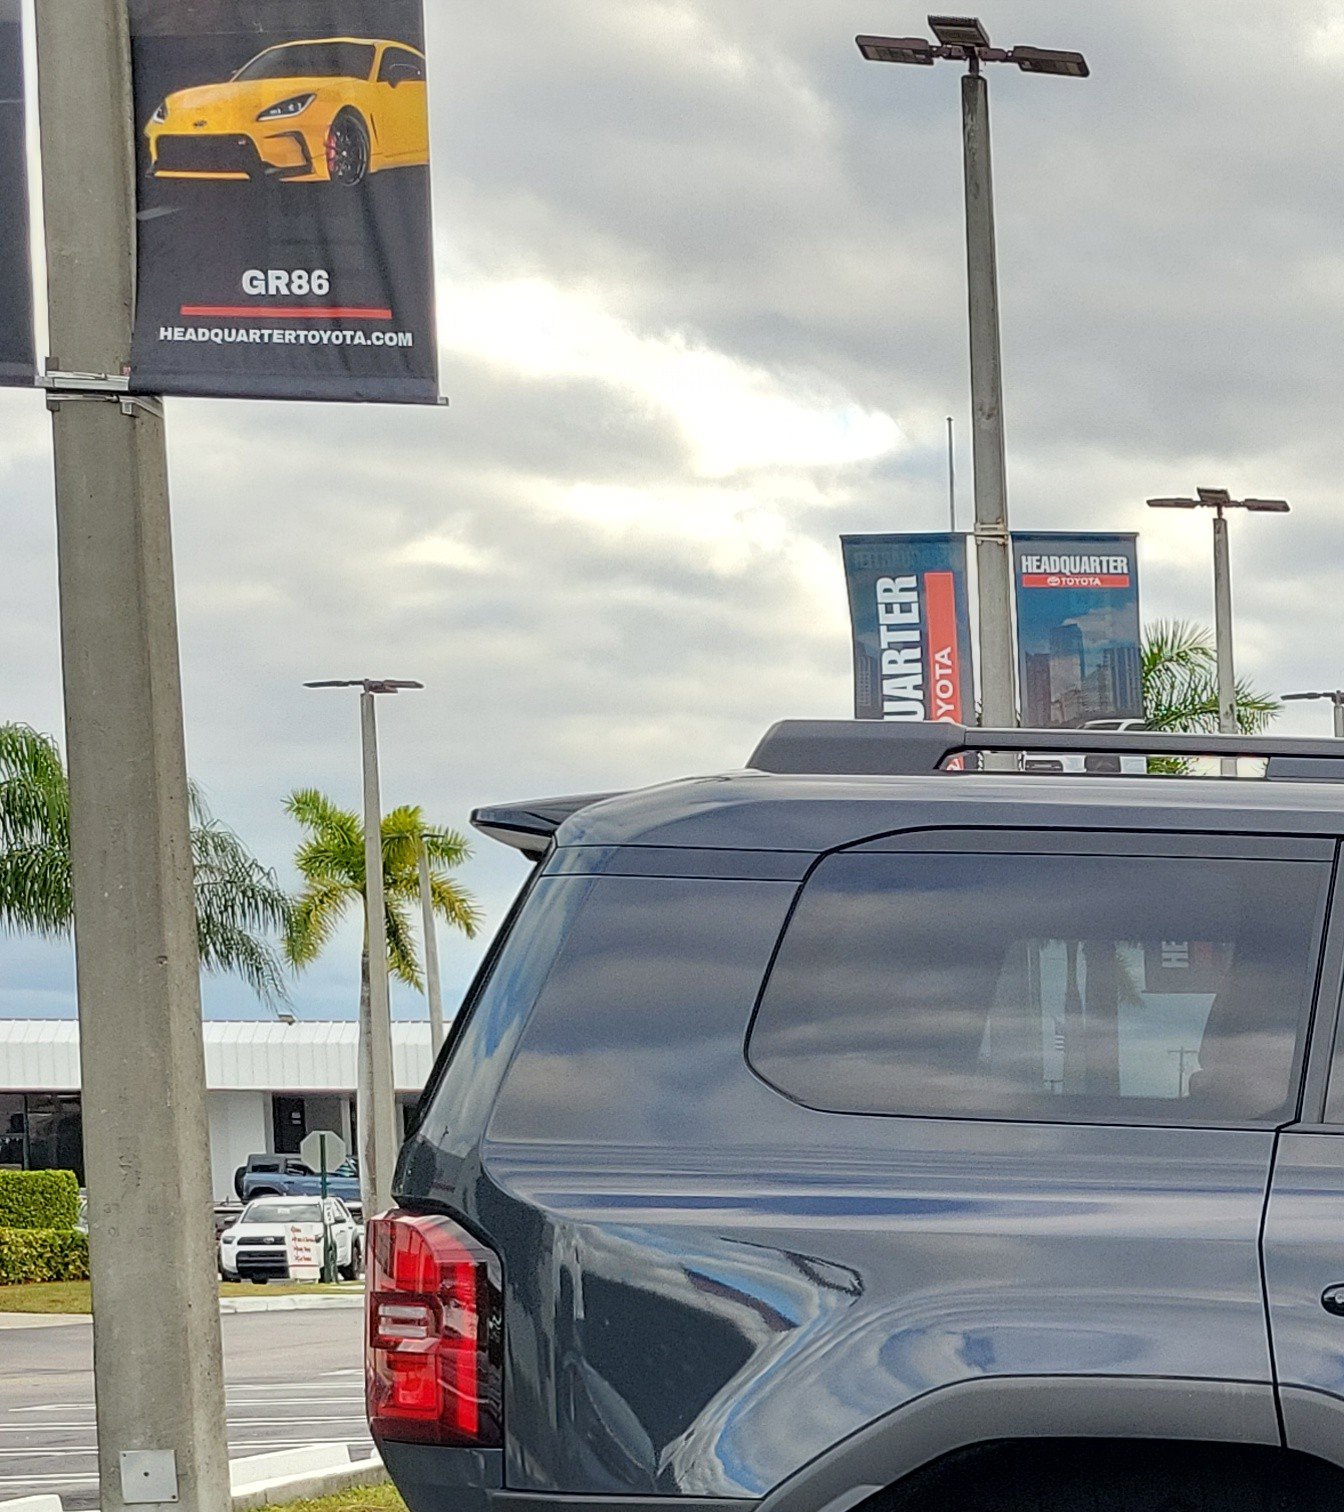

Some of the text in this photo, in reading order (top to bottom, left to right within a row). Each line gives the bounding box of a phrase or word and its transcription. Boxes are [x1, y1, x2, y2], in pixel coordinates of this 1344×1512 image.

[242, 269, 330, 297] GR86
[159, 326, 413, 347] HEADQUARTERTOYOTA.COM
[1021, 555, 1129, 575] HEADQUARTER
[1062, 577, 1101, 586] TOYOTA
[876, 574, 925, 722] UARTER
[935, 646, 955, 723] YOTA
